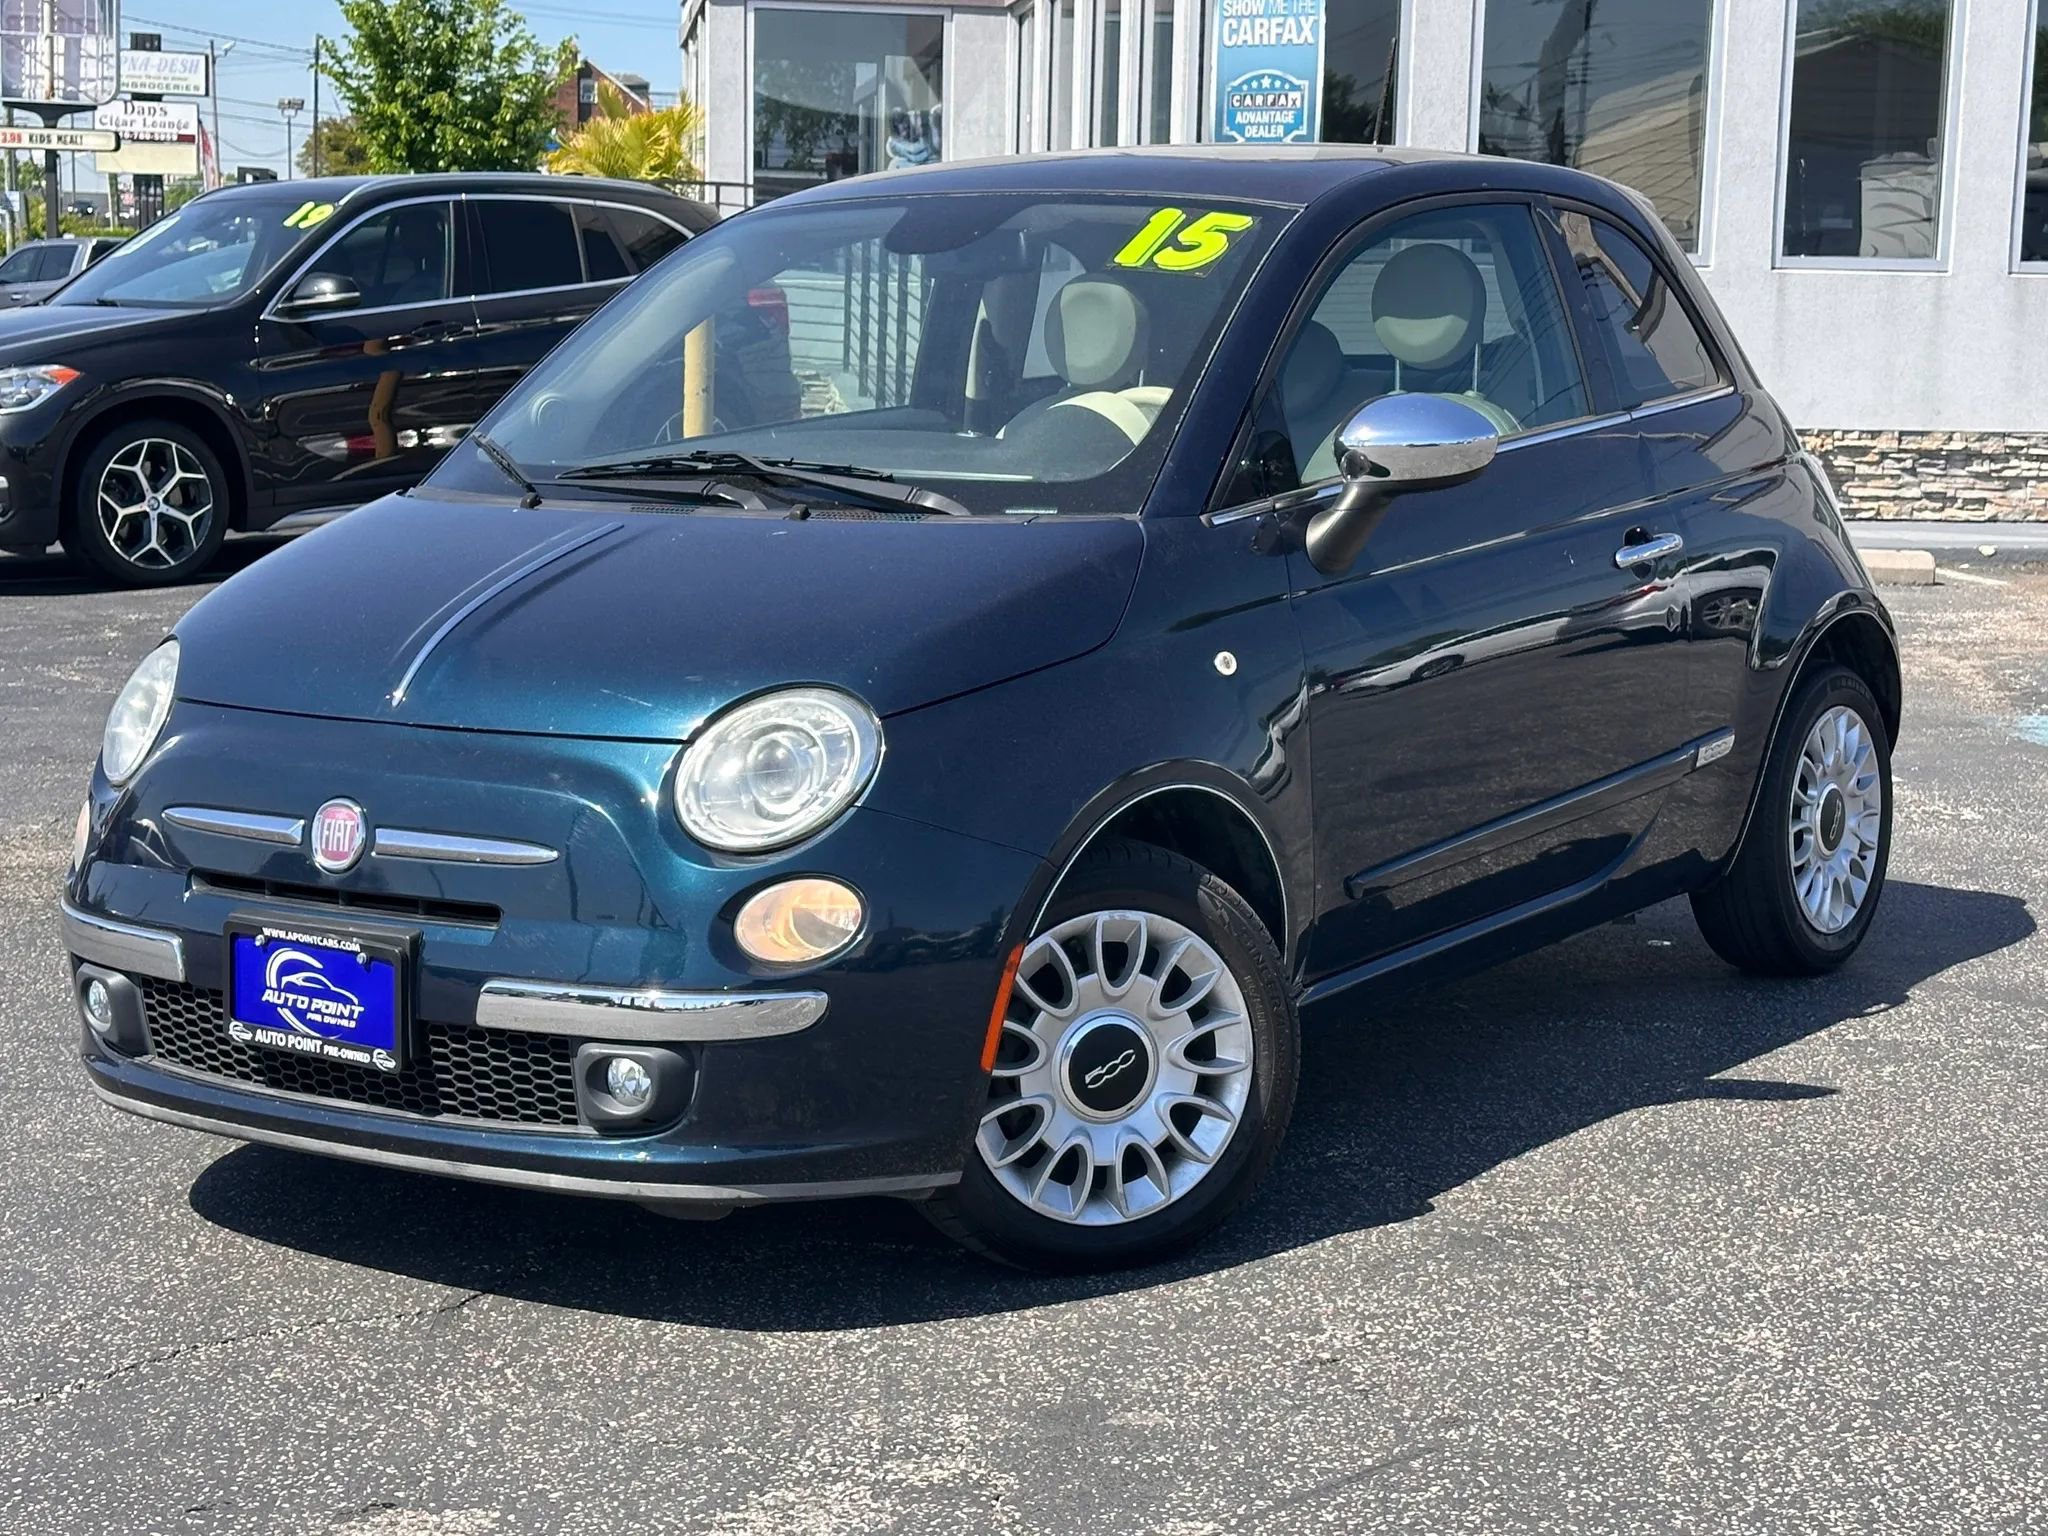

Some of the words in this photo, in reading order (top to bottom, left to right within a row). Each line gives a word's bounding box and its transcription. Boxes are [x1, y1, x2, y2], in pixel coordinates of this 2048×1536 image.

[1223, 0, 1265, 17] SHOW
[1268, 0, 1288, 15] ME
[1292, 0, 1316, 14] THE
[1223, 16, 1316, 47] CARFAX
[123, 100, 168, 117] Dan's
[1231, 93, 1300, 108] CARFAX
[98, 114, 137, 129] Cigar
[142, 117, 190, 131] Lounge
[1235, 111, 1296, 124] ADVANTAGE
[29, 132, 52, 145] KIDS
[1244, 125, 1285, 138] DEALER
[282, 200, 335, 229] 19
[1112, 207, 1254, 272] 15
[321, 818, 355, 852] FIAT
[262, 927, 361, 953] WWW.APOINTCARS.COM
[262, 989, 309, 1010] AUTO
[311, 998, 365, 1020] POINT
[255, 1029, 286, 1047] AUTO
[287, 1034, 322, 1054] POINT
[323, 1044, 371, 1064] PRE-OWNED
